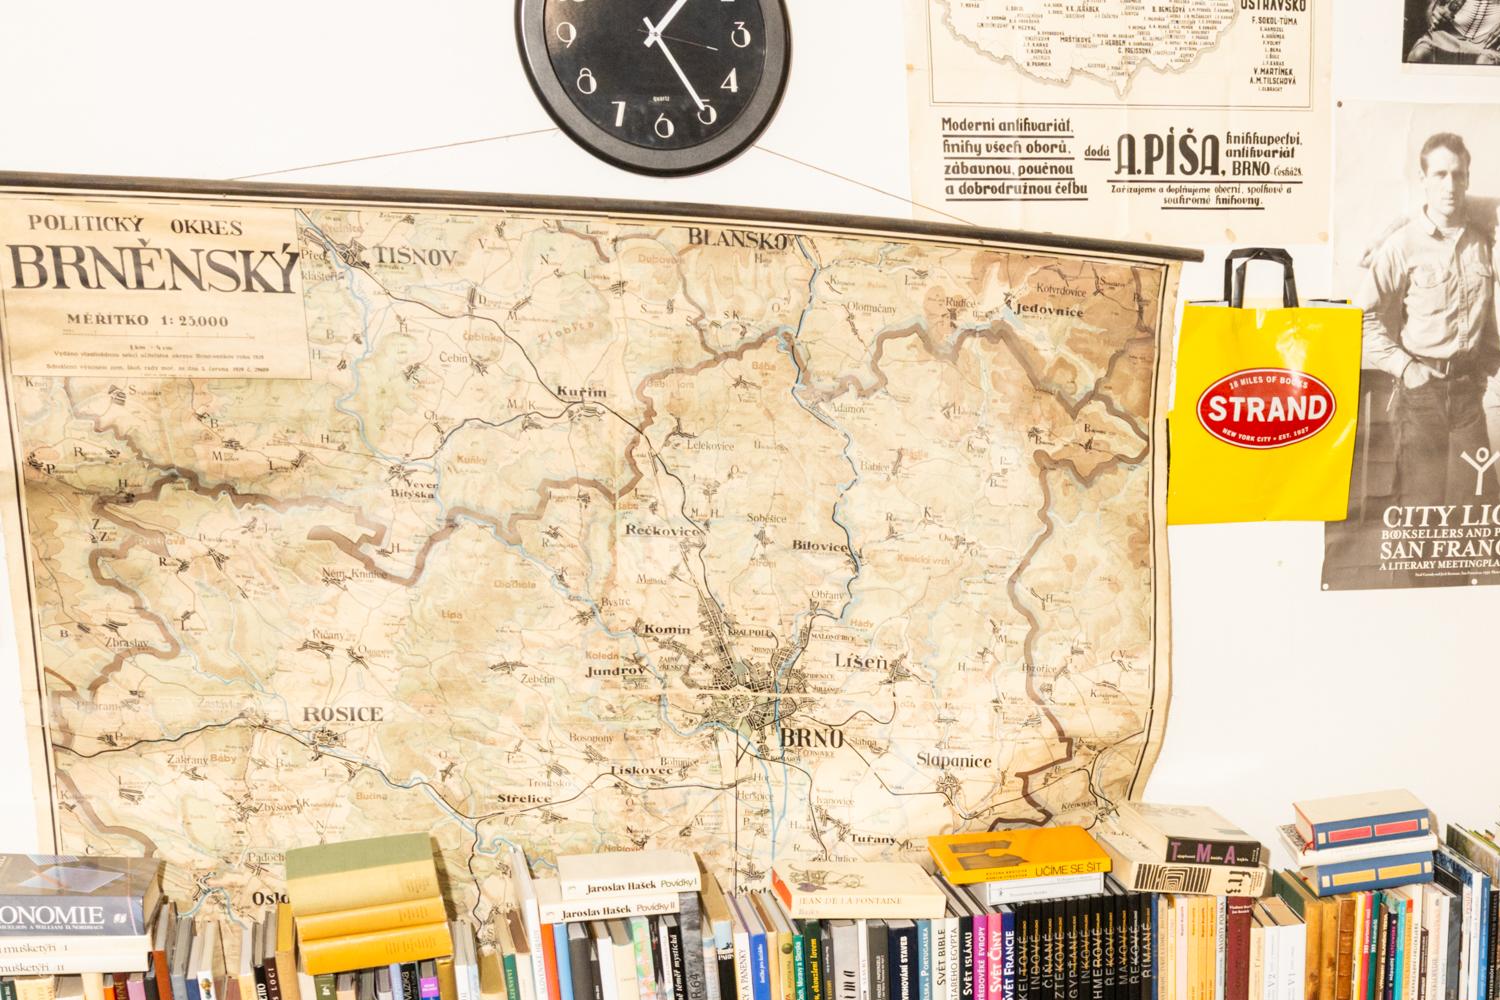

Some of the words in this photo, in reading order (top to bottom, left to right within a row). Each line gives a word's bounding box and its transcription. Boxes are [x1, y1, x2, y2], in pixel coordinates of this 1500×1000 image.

[556, 22, 576, 48] 9
[731, 22, 750, 47] 3
[577, 68, 597, 94] 8
[720, 68, 738, 92] 4
[611, 101, 626, 126] 7
[698, 99, 716, 124] 5
[655, 113, 674, 138] 6
[944, 140, 982, 155] knihy
[985, 140, 1021, 154] všech
[1085, 146, 1110, 157] dodá
[1018, 162, 1073, 177] poučnou
[1233, 161, 1270, 176] BRNO
[946, 186, 954, 194] a
[958, 180, 1052, 194] dobrodružnou
[1055, 181, 1087, 194] četbu
[28, 214, 144, 232] POLITICKÝ
[171, 218, 243, 236] OKRES
[688, 227, 788, 250] BLANSKO
[5, 238, 300, 294] BRNĚNSKÝ
[376, 246, 459, 267] TIŠNOV
[1015, 302, 1084, 318] Jedovnice
[1239, 376, 1263, 387] MILES
[1266, 375, 1277, 384] OF
[1208, 394, 1328, 423] STRAND
[1222, 427, 1238, 438] NEW
[1239, 433, 1255, 442] YORK
[1278, 431, 1293, 441] EST.
[1383, 505, 1456, 528] CITY
[1381, 528, 1464, 540] BOOKSELLERS
[1466, 528, 1491, 537] AND
[1380, 540, 1426, 560] SAN
[1380, 561, 1388, 571] A
[1390, 560, 1435, 570] LITERARY
[835, 652, 888, 670] Líšeň
[585, 665, 646, 678] Jundrov
[303, 705, 384, 722] ROSICE
[781, 728, 844, 748] BRNO
[1035, 865, 1068, 877] UČÍME
[1069, 864, 1084, 873] SE
[1086, 861, 1101, 872] ŠÍT
[586, 883, 625, 895] Jaroslav
[628, 880, 657, 890] Hašek
[661, 879, 692, 889] Povídky
[561, 907, 600, 920] Jaroslav
[603, 905, 631, 916] Hašek
[636, 902, 667, 914] Povídky
[963, 931, 973, 964] ISLÁMU
[1003, 930, 1015, 975] FRANCIE
[963, 966, 973, 996] SVĚT
